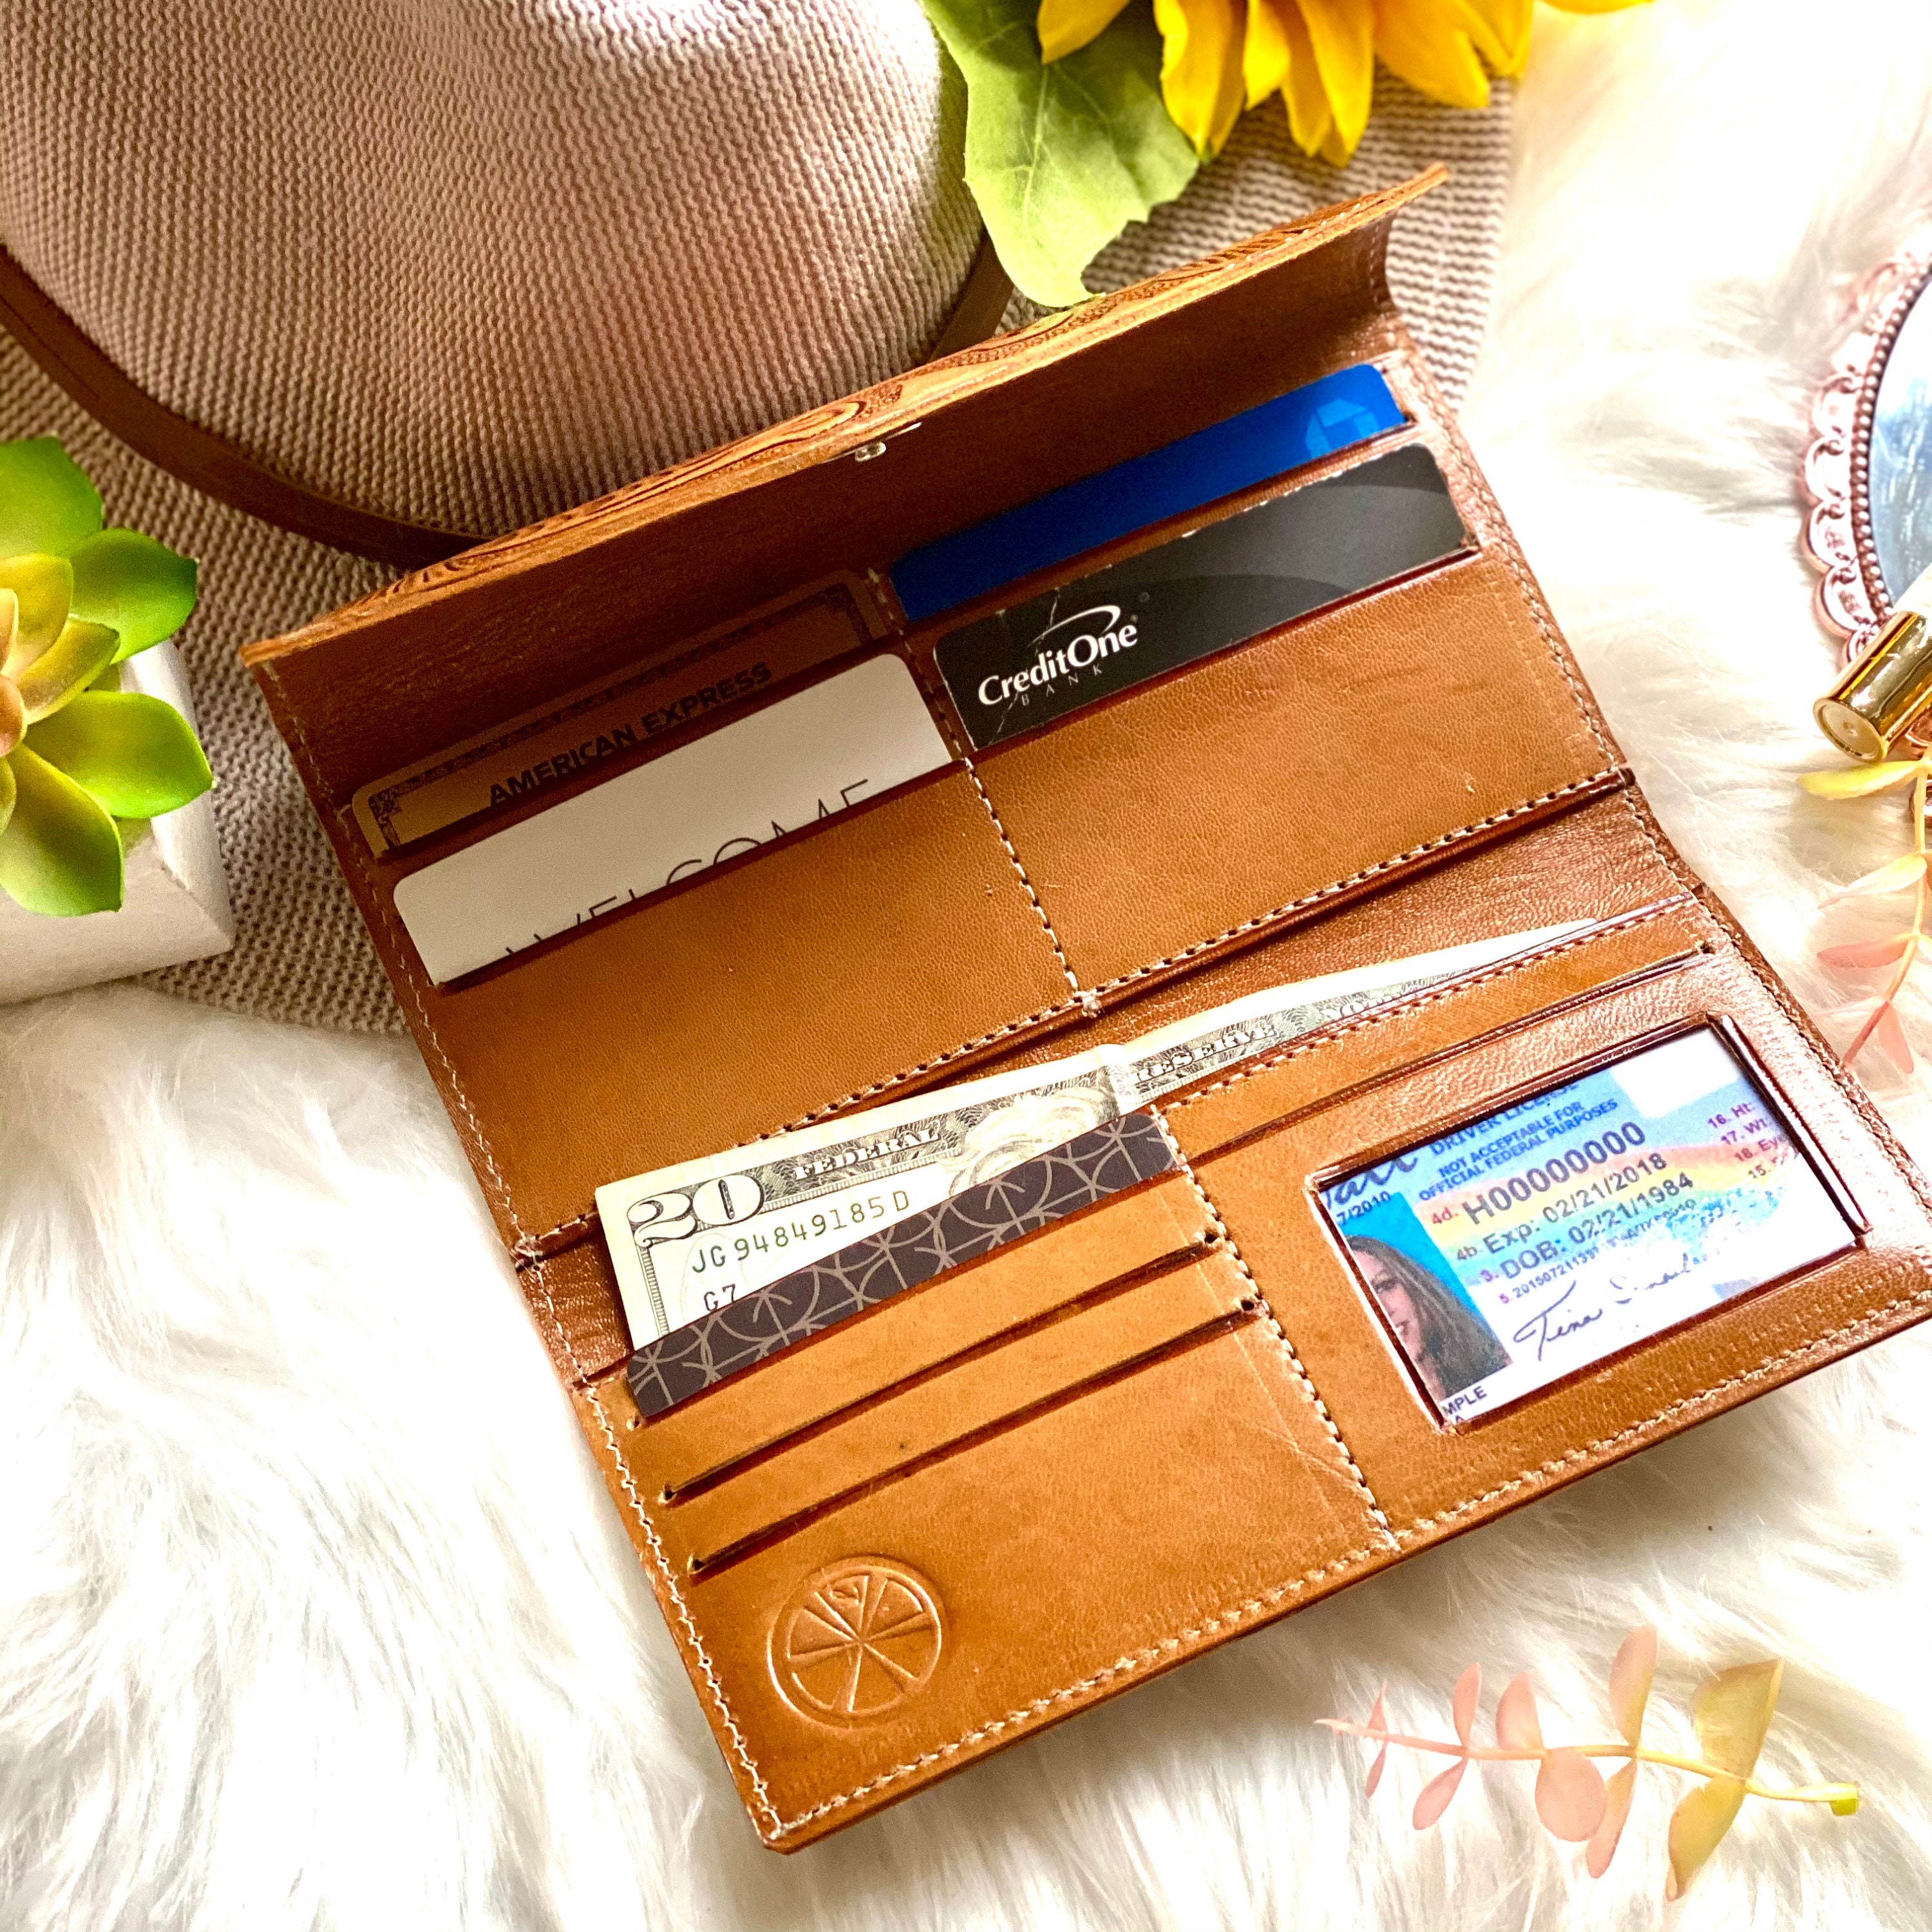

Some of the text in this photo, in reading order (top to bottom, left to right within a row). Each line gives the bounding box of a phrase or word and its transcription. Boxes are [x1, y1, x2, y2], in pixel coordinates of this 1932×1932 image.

[978, 625, 1138, 705] CreditOne
[1021, 665, 1102, 706] BANK
[489, 661, 772, 807] AMERICAN EXPRESS
[794, 1128, 942, 1180] FEDERAL
[1419, 1162, 1486, 1201] OFFICIAL
[1484, 1133, 1546, 1169] FEDERAL
[1546, 1098, 1618, 1139] PURPOSES
[1437, 1101, 1585, 1178] NOT ACCEPTABLE FOR
[1462, 1122, 1646, 1226] H00000000
[627, 1174, 766, 1249] 20
[1482, 1218, 1541, 1255] Exp:
[1542, 1151, 1668, 1224] 02/21/2018
[1499, 1238, 1567, 1280] DOB:
[1567, 1172, 1694, 1244] 02/21/1984
[703, 1283, 737, 1312] G7
